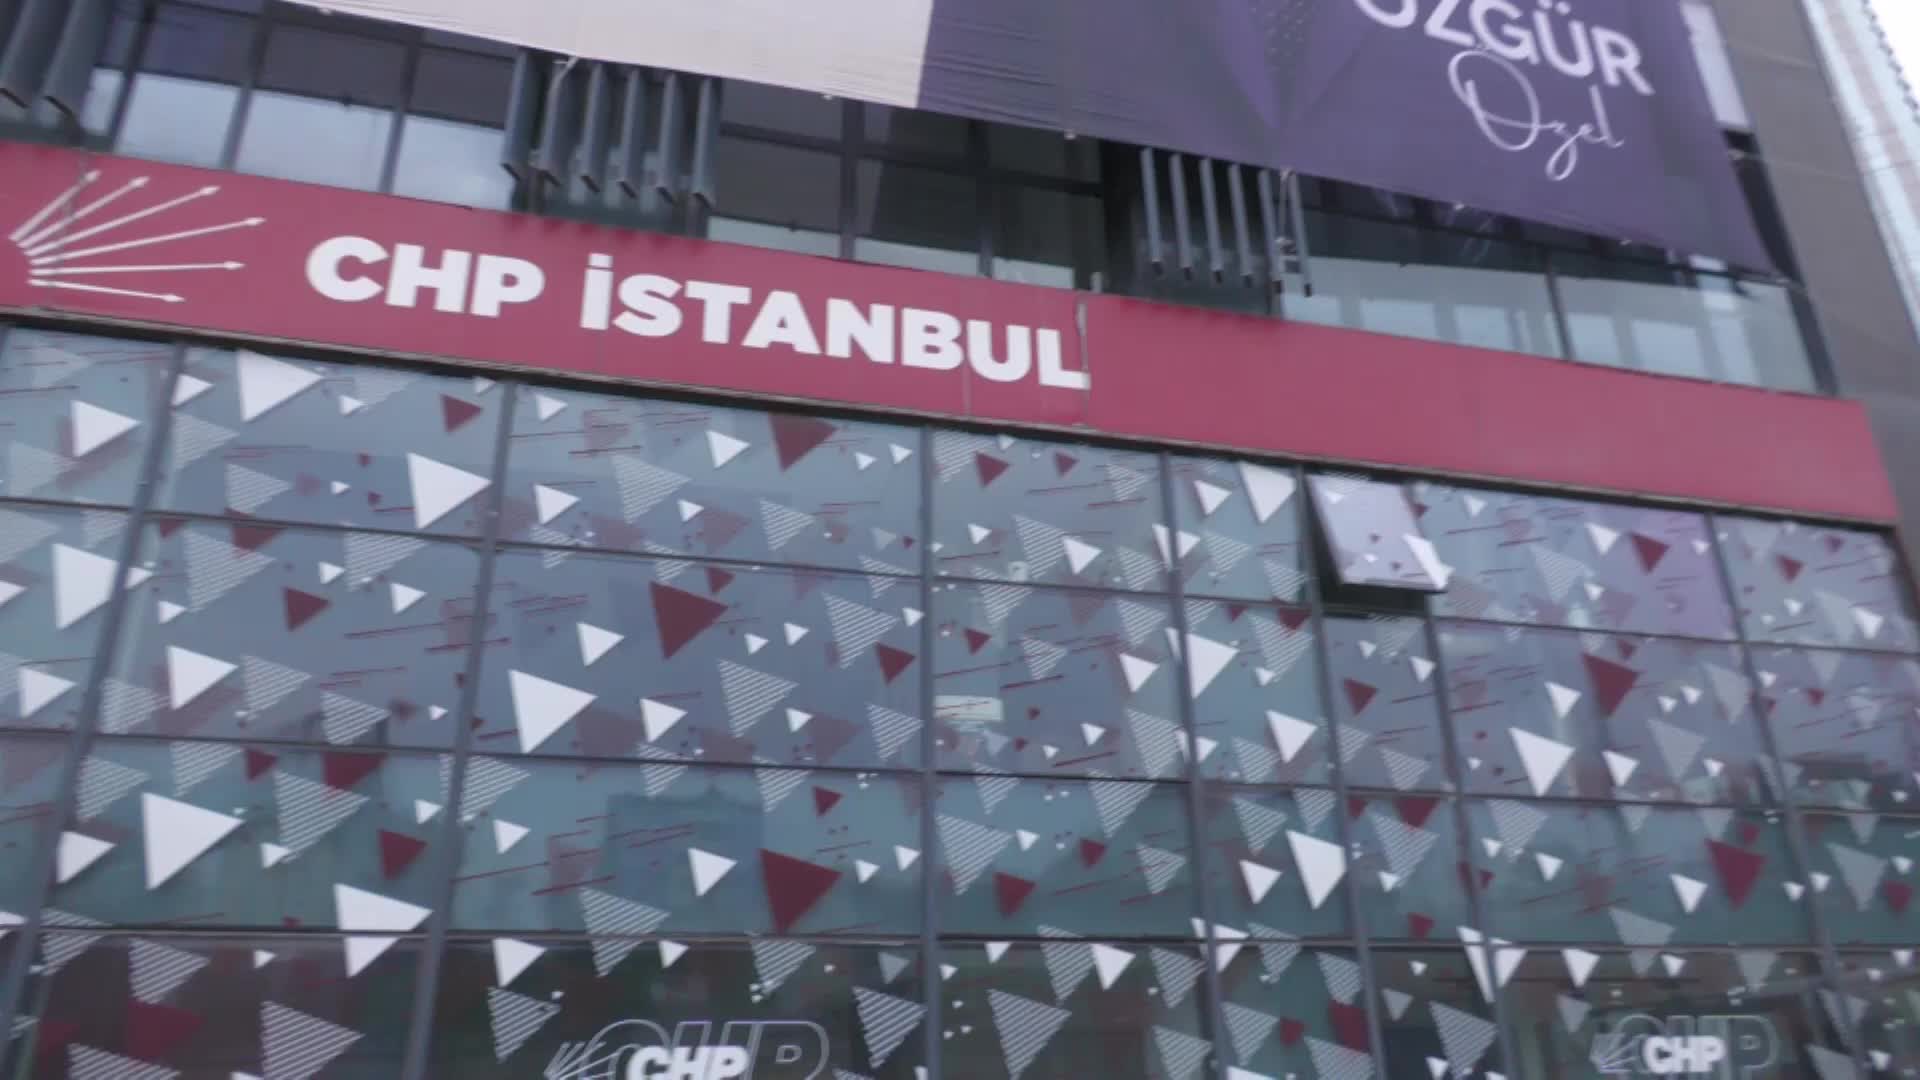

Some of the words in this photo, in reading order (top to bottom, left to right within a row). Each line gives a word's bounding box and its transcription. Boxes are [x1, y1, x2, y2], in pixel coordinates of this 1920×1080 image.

[305, 235, 546, 318] CHP
[579, 252, 1090, 391] İSTANBUL
[626, 1045, 749, 1080] CHP
[1643, 1034, 1727, 1074] CHP
